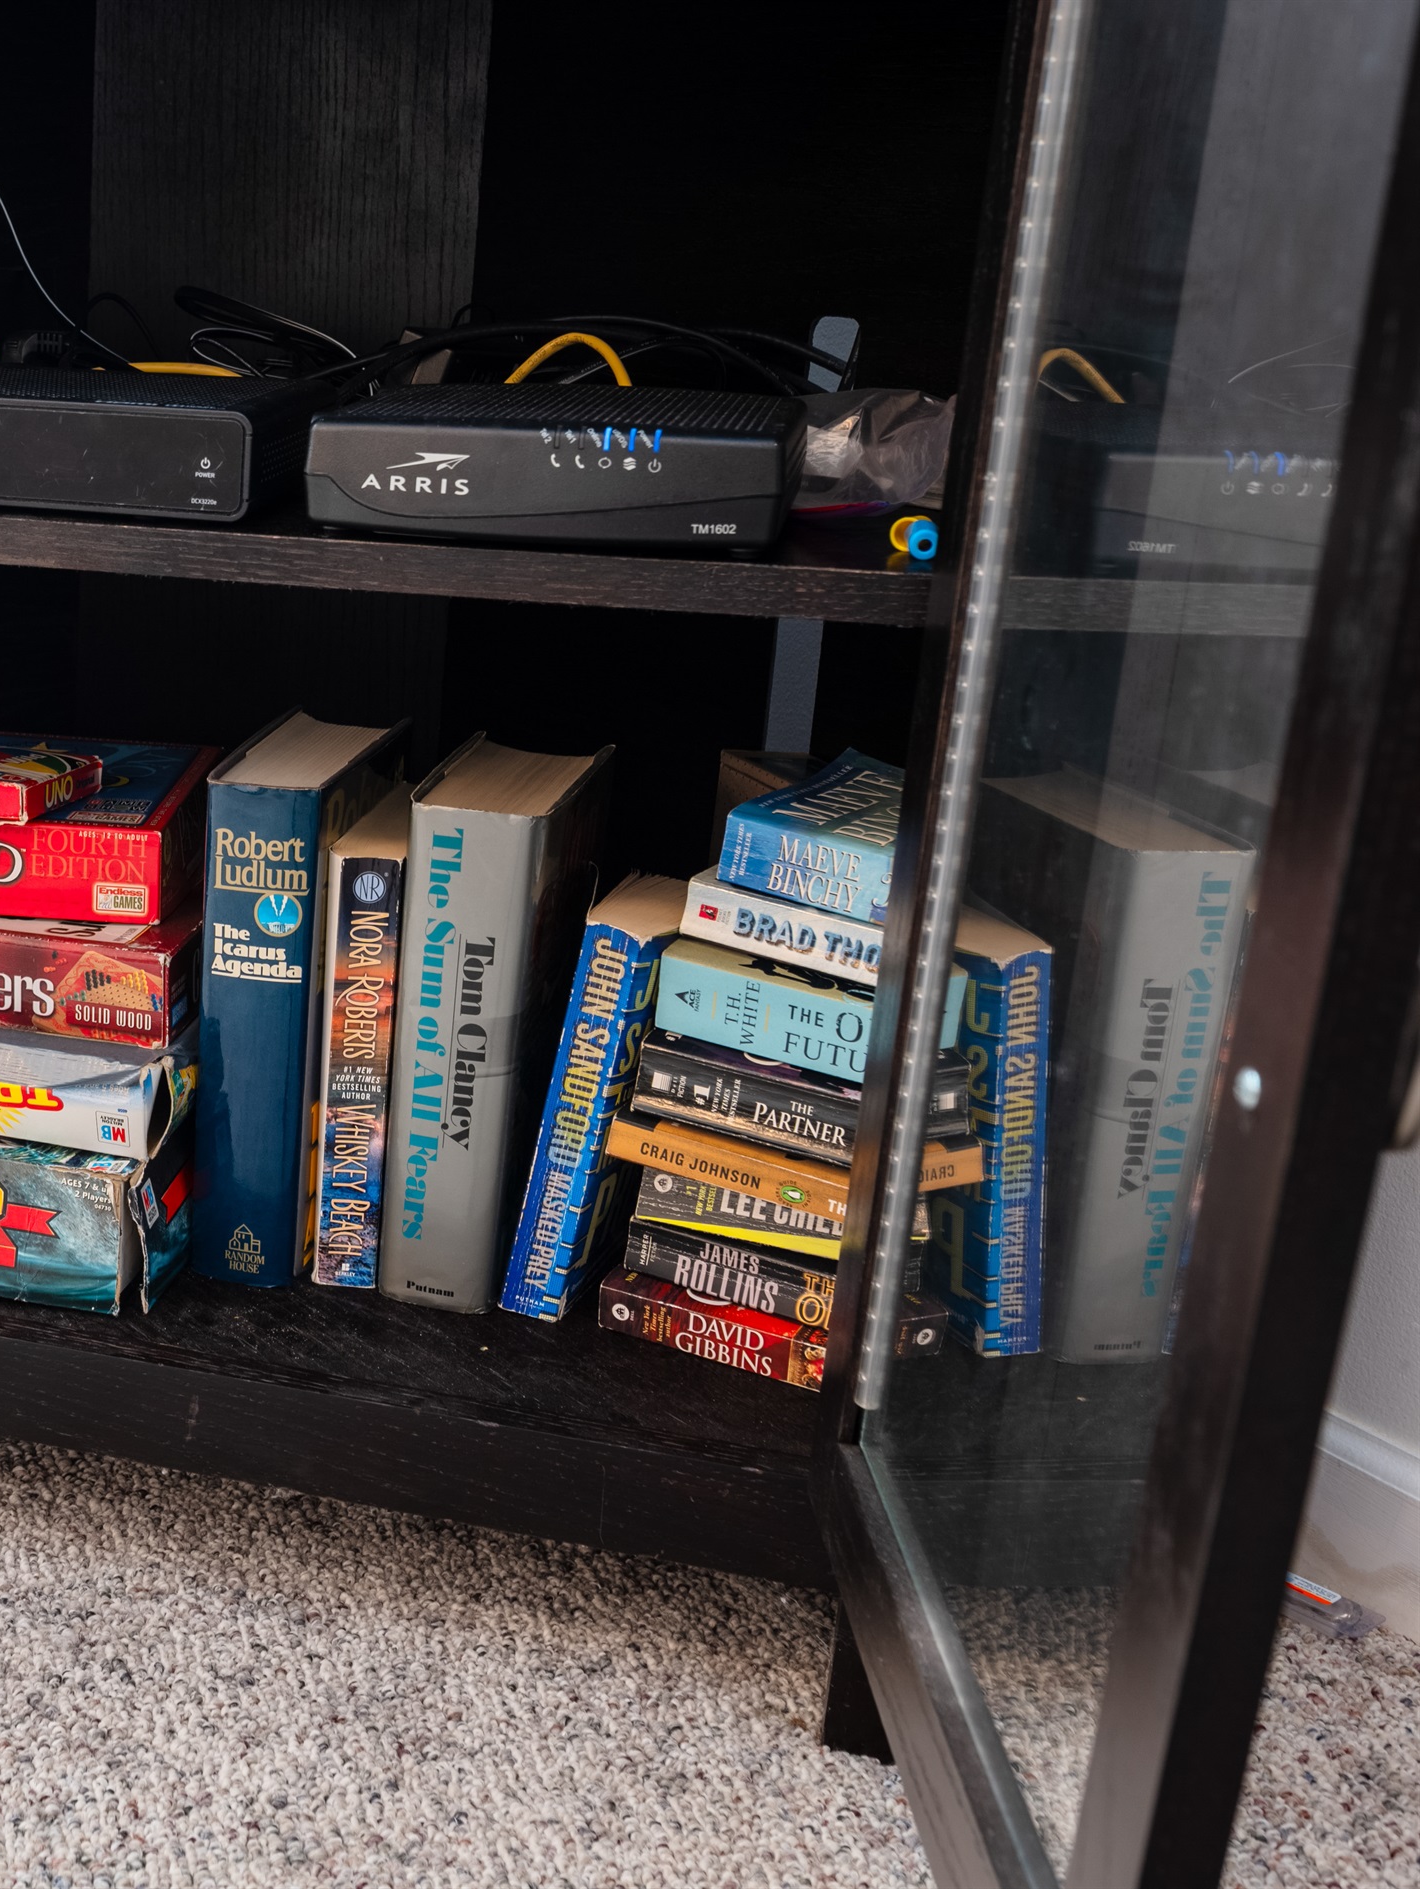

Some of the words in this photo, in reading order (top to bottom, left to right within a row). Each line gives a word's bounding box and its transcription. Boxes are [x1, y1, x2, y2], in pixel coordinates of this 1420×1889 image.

[194, 471, 216, 479] POWER
[360, 473, 470, 496] ARRIS
[690, 522, 738, 536] TM1602
[44, 777, 74, 809] UNO
[771, 769, 904, 826] MAEVE
[31, 827, 148, 859] FOURTH
[78, 830, 99, 839] AGES:
[126, 832, 149, 842] ADULT
[214, 827, 306, 863] Robert
[30, 853, 148, 884] EDITION
[424, 827, 465, 910] The
[738, 831, 753, 877] BESTSELLER
[777, 834, 863, 883] MAEVE
[213, 855, 309, 894] Ludlum
[766, 862, 863, 914] BINCHY
[98, 886, 144, 897] Endless
[112, 895, 144, 910] GAMES
[213, 922, 251, 941] The
[348, 910, 390, 969] NORA
[733, 907, 817, 955] BRAD
[213, 937, 287, 961] Icarus
[418, 916, 457, 1009] Sum
[211, 954, 303, 980] Agenda
[459, 936, 496, 1016] Tom
[580, 937, 628, 1021] JOHN
[688, 988, 697, 1009] ACE
[724, 992, 742, 1025] T.H.
[739, 980, 761, 1046] WHITE
[74, 1004, 111, 1026] SOLID
[116, 1011, 153, 1032] WOOD
[335, 972, 384, 1060] ROBERTS
[788, 1004, 825, 1029] THE
[415, 1015, 447, 1055] of
[782, 1031, 869, 1074] FUTU
[335, 1074, 356, 1083] YORK
[357, 1075, 381, 1084] TIMES
[342, 1066, 353, 1074] #1
[355, 1066, 374, 1075] NEW
[441, 1020, 489, 1152] Clancy
[332, 1083, 382, 1093] BESTSELLING
[340, 1091, 371, 1101] AUTHOR
[409, 1052, 446, 1123] All
[547, 1021, 612, 1169] SANDFORD
[693, 1083, 712, 1106] #1
[752, 1101, 847, 1147] PARTNER
[790, 1100, 815, 1116] THE
[100, 1124, 126, 1144] MB
[332, 1104, 377, 1194] WHISKEY
[640, 1141, 686, 1167] CRAIG
[688, 1157, 762, 1190] JOHNSON
[60, 1177, 82, 1188] AGES
[84, 1181, 91, 1189] 7
[92, 1183, 100, 1191] &
[74, 1190, 81, 1198] 2
[82, 1190, 112, 1204] Players
[401, 1128, 439, 1242] Fears
[535, 1170, 573, 1243] MASKED
[720, 1188, 767, 1221] LEE
[327, 1198, 371, 1257] BEACH
[223, 1248, 265, 1266] RANDOM
[638, 1233, 650, 1266] HARPER
[699, 1242, 760, 1275] JAMES
[228, 1260, 260, 1275] HOUSE
[524, 1243, 556, 1291] PREY
[405, 1279, 456, 1299] Putnam
[673, 1254, 779, 1314] ROLLINS
[515, 1295, 545, 1307] PUTNAM
[650, 1312, 658, 1334] Times
[656, 1305, 668, 1342] bestselling
[664, 1313, 673, 1339] author
[687, 1311, 765, 1351] DAVID
[675, 1331, 773, 1377] GIBBINS
